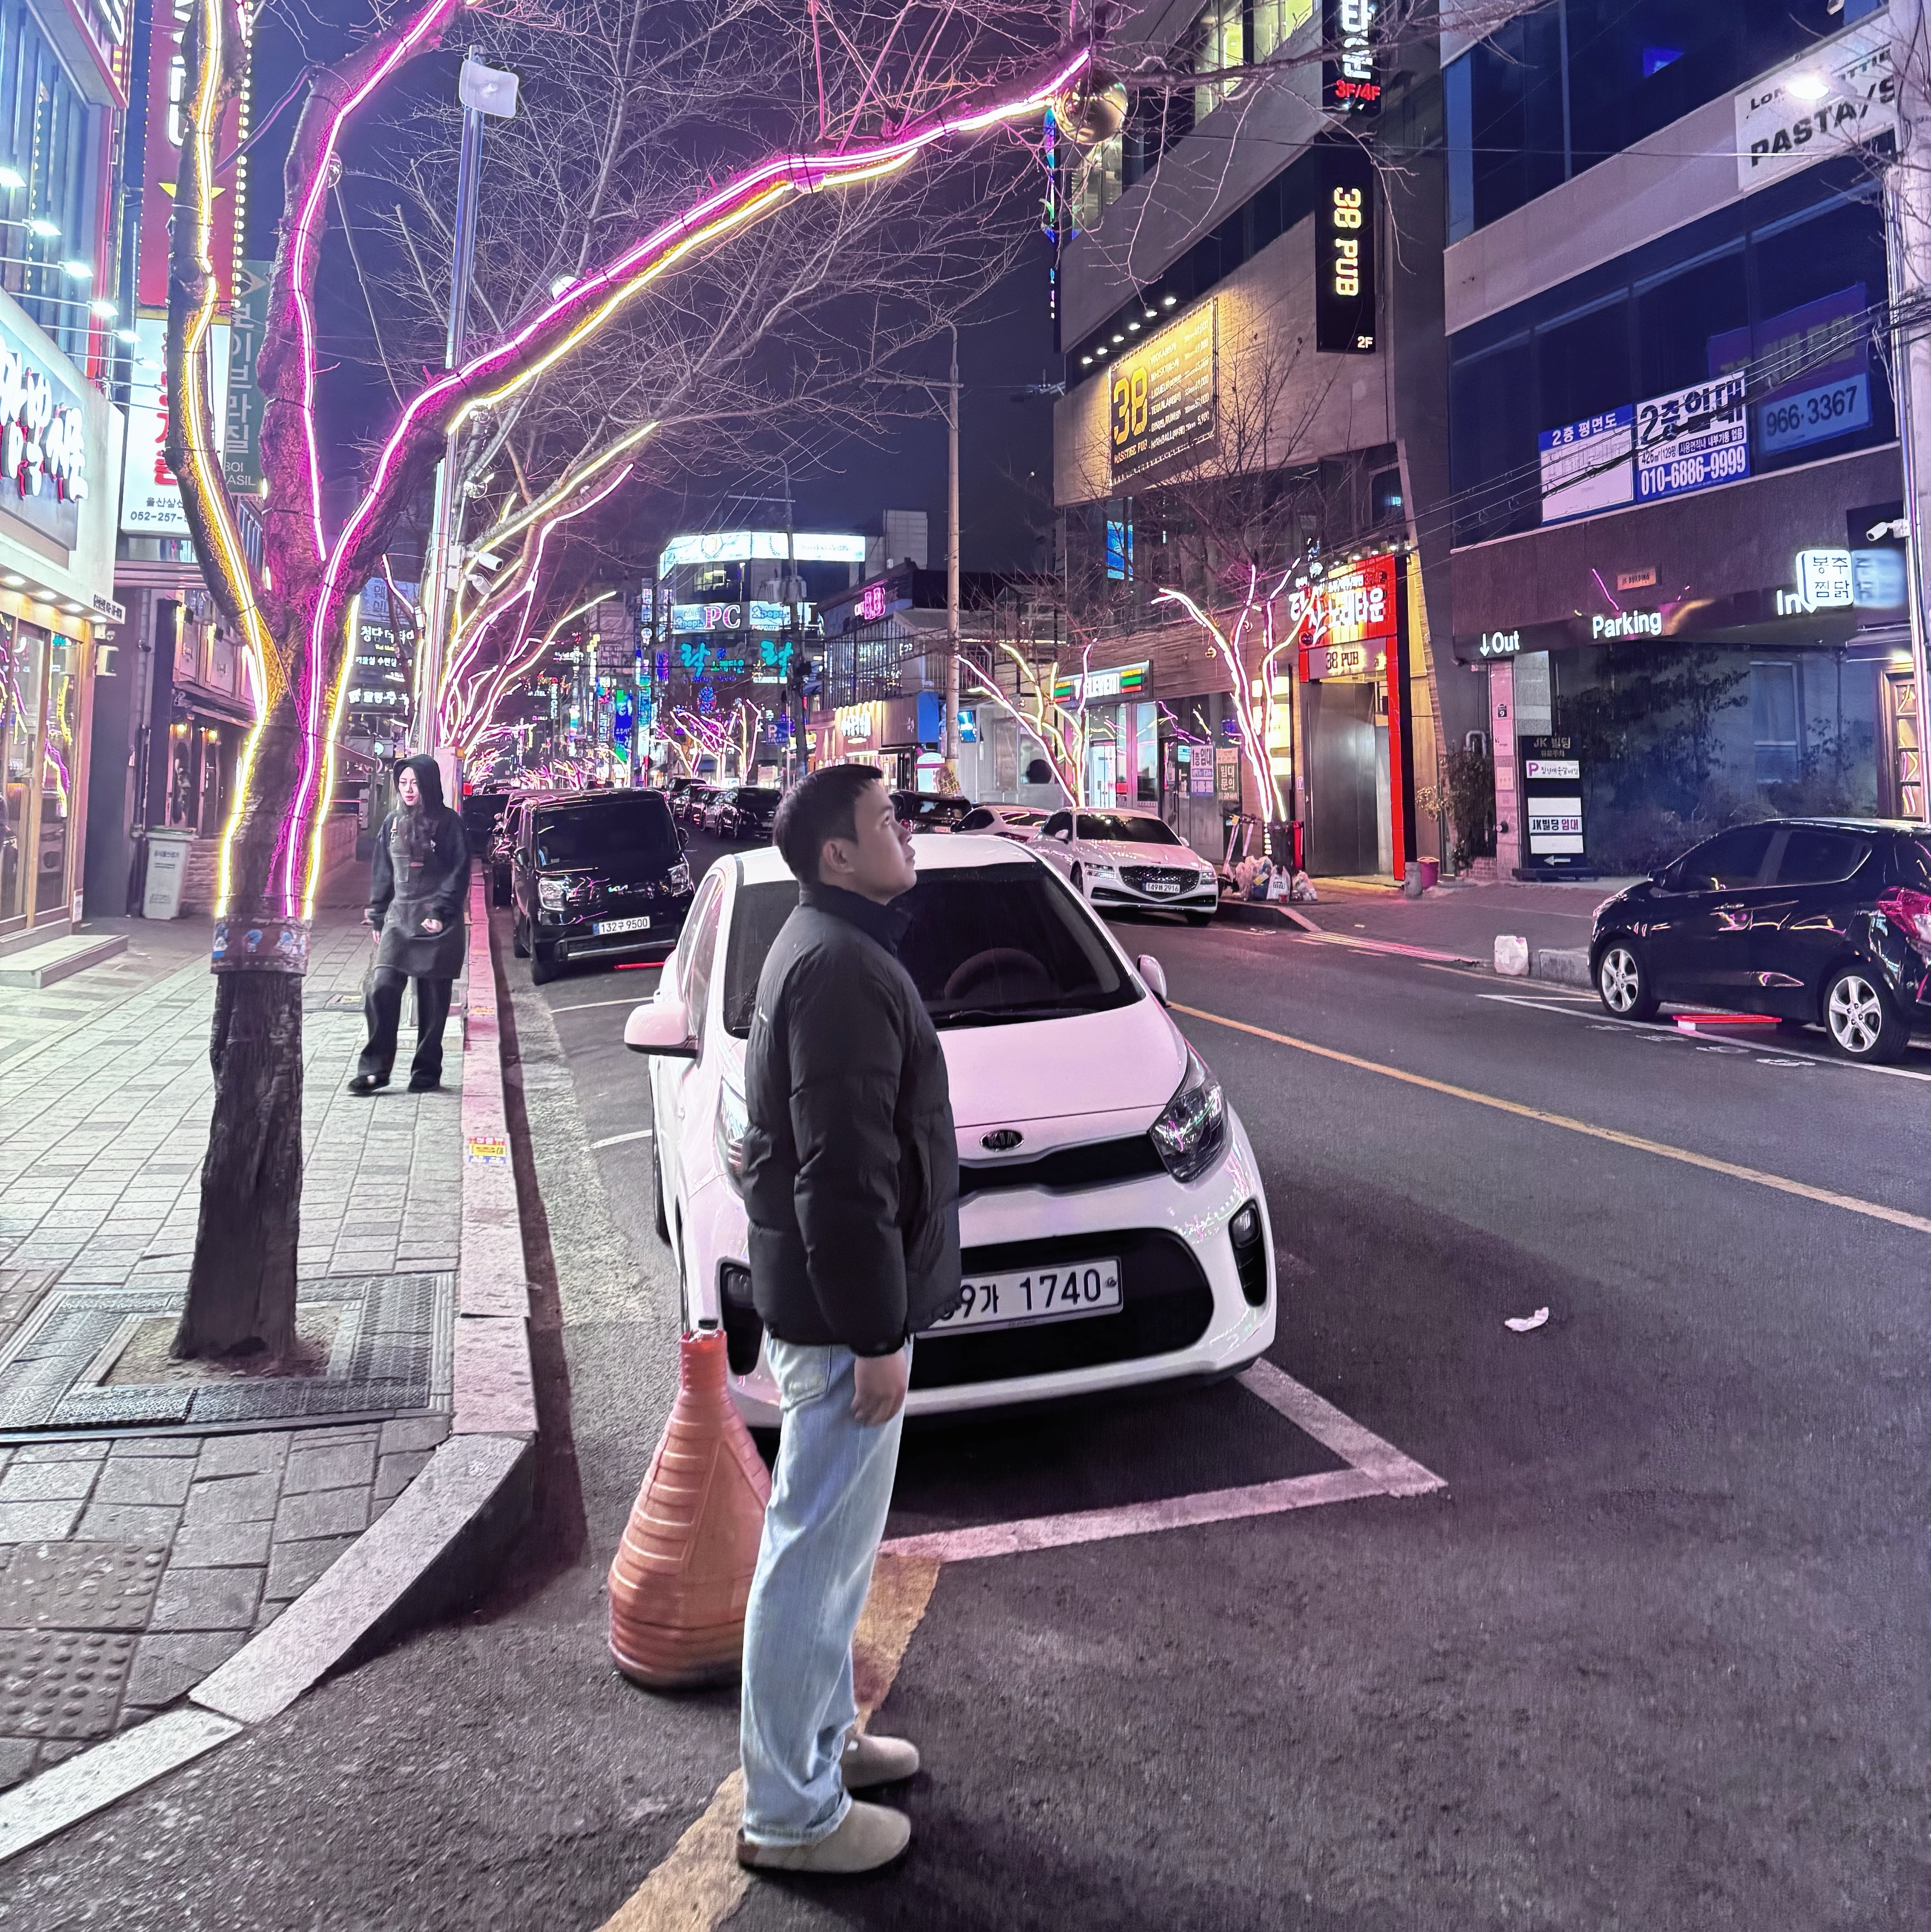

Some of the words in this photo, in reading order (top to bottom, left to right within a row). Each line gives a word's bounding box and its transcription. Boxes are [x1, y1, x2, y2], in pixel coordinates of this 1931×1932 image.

[1335, 79, 1381, 101] 3F/4F
[1334, 187, 1362, 229] 38
[1335, 238, 1359, 297] PUB
[1357, 336, 1373, 349] 2F
[1113, 366, 1148, 445] 38
[1552, 426, 1574, 446] 2층
[1578, 413, 1617, 437] 평면도
[1708, 431, 1730, 446] 내부기둥
[1731, 427, 1743, 441] 없음
[1641, 445, 1746, 496] 010-6886-9999
[227, 475, 256, 486] ASIL
[1813, 556, 1848, 574] 봉추
[1815, 580, 1850, 598] 찜닭
[1776, 589, 1802, 615] In
[704, 604, 741, 630] PC
[1592, 610, 1662, 639] Parking
[1491, 630, 1520, 653] Out
[1326, 651, 1338, 670] 38
[1341, 651, 1359, 667] PUB
[767, 724, 777, 738] P
[1534, 737, 1547, 748] JK
[1551, 737, 1570, 749] 빌딩
[1220, 765, 1234, 778] 임대
[1529, 762, 1539, 777] P
[1220, 778, 1234, 790] 문의
[1532, 819, 1559, 831] JK빌딩
[1561, 819, 1578, 831] 임대
[601, 922, 624, 933] 132구
[626, 918, 648, 930] 9500
[940, 1283, 999, 1321] 9가
[1019, 1268, 1101, 1311] 1740
